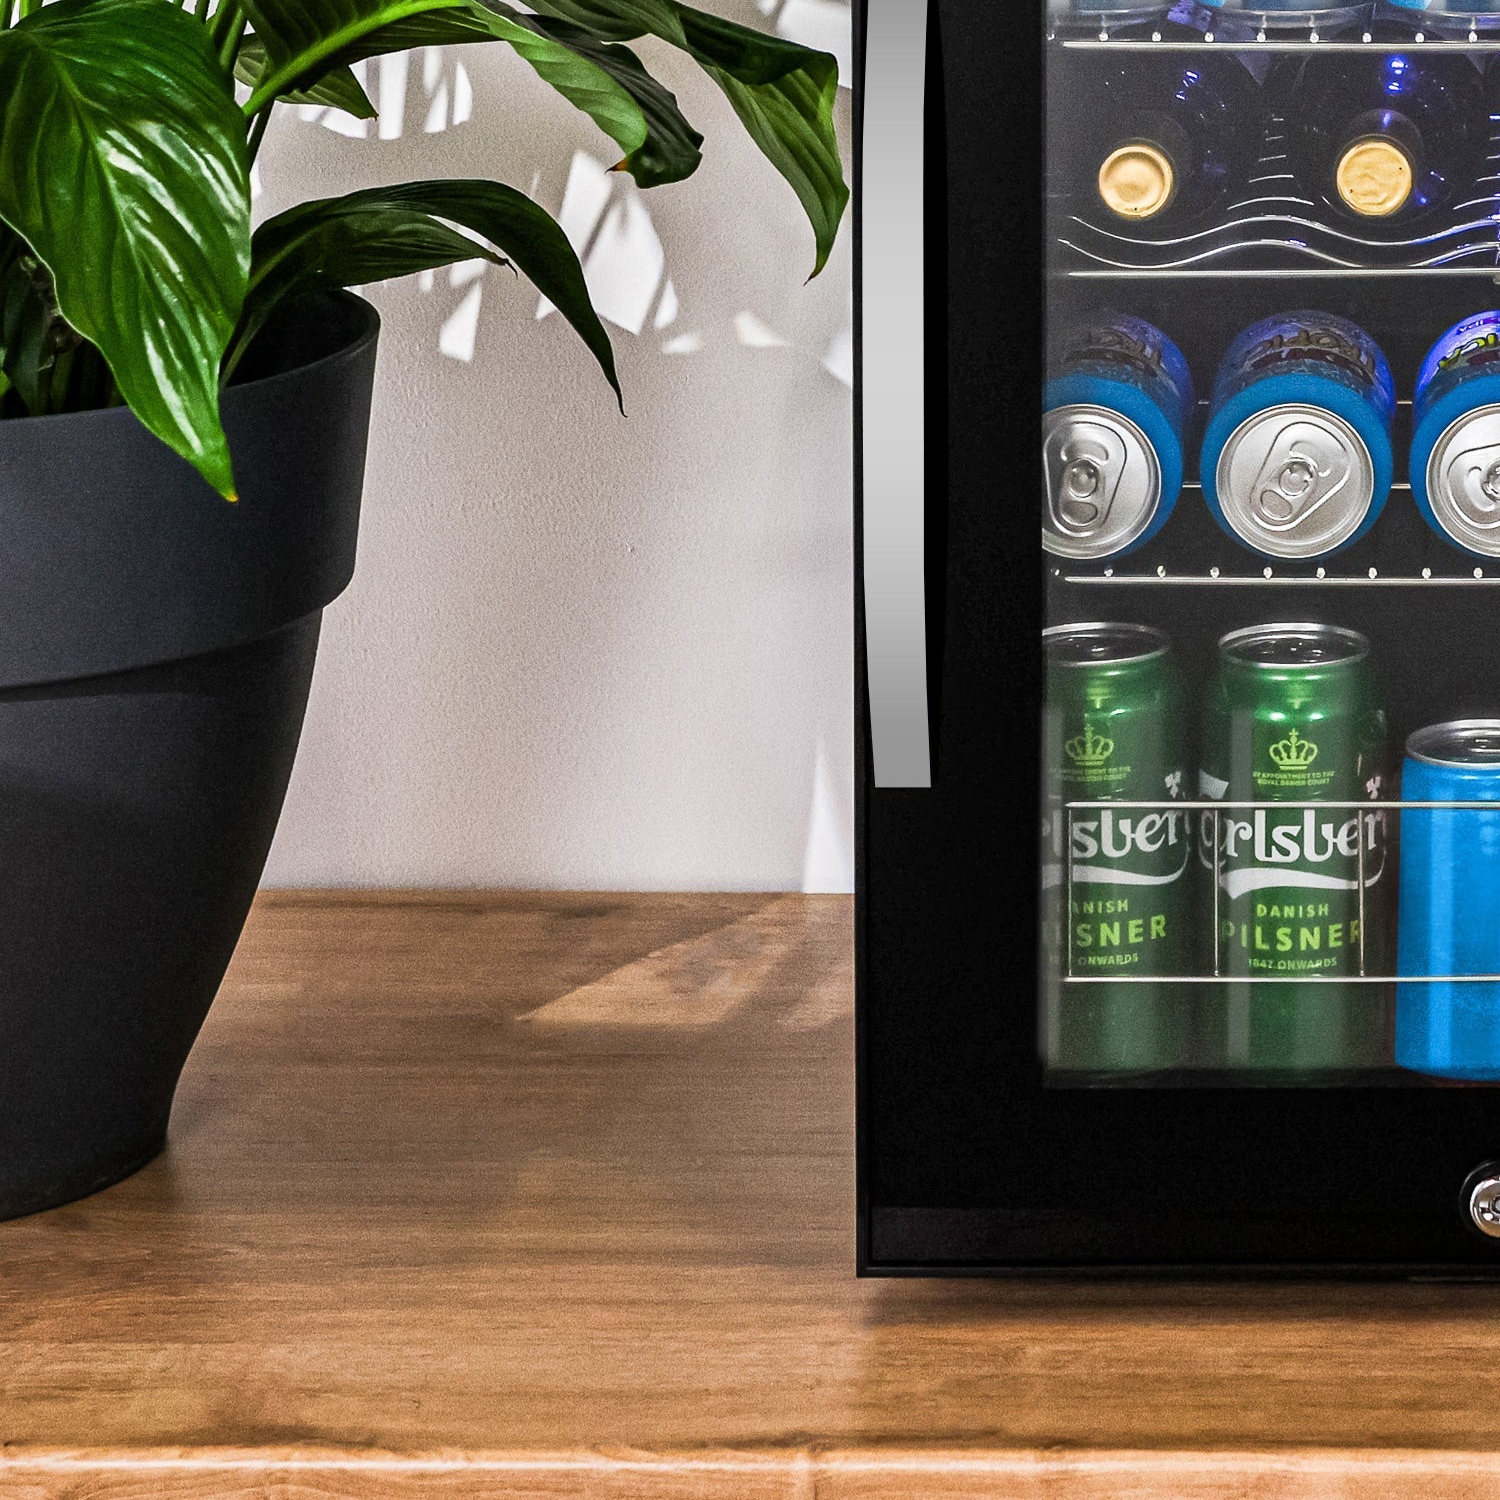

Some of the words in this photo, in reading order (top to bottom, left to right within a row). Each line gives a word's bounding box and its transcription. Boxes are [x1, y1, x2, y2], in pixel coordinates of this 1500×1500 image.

[1256, 903, 1329, 918] DANISH
[1076, 914, 1166, 947] SNER
[1277, 957, 1337, 970] ONWARDS
